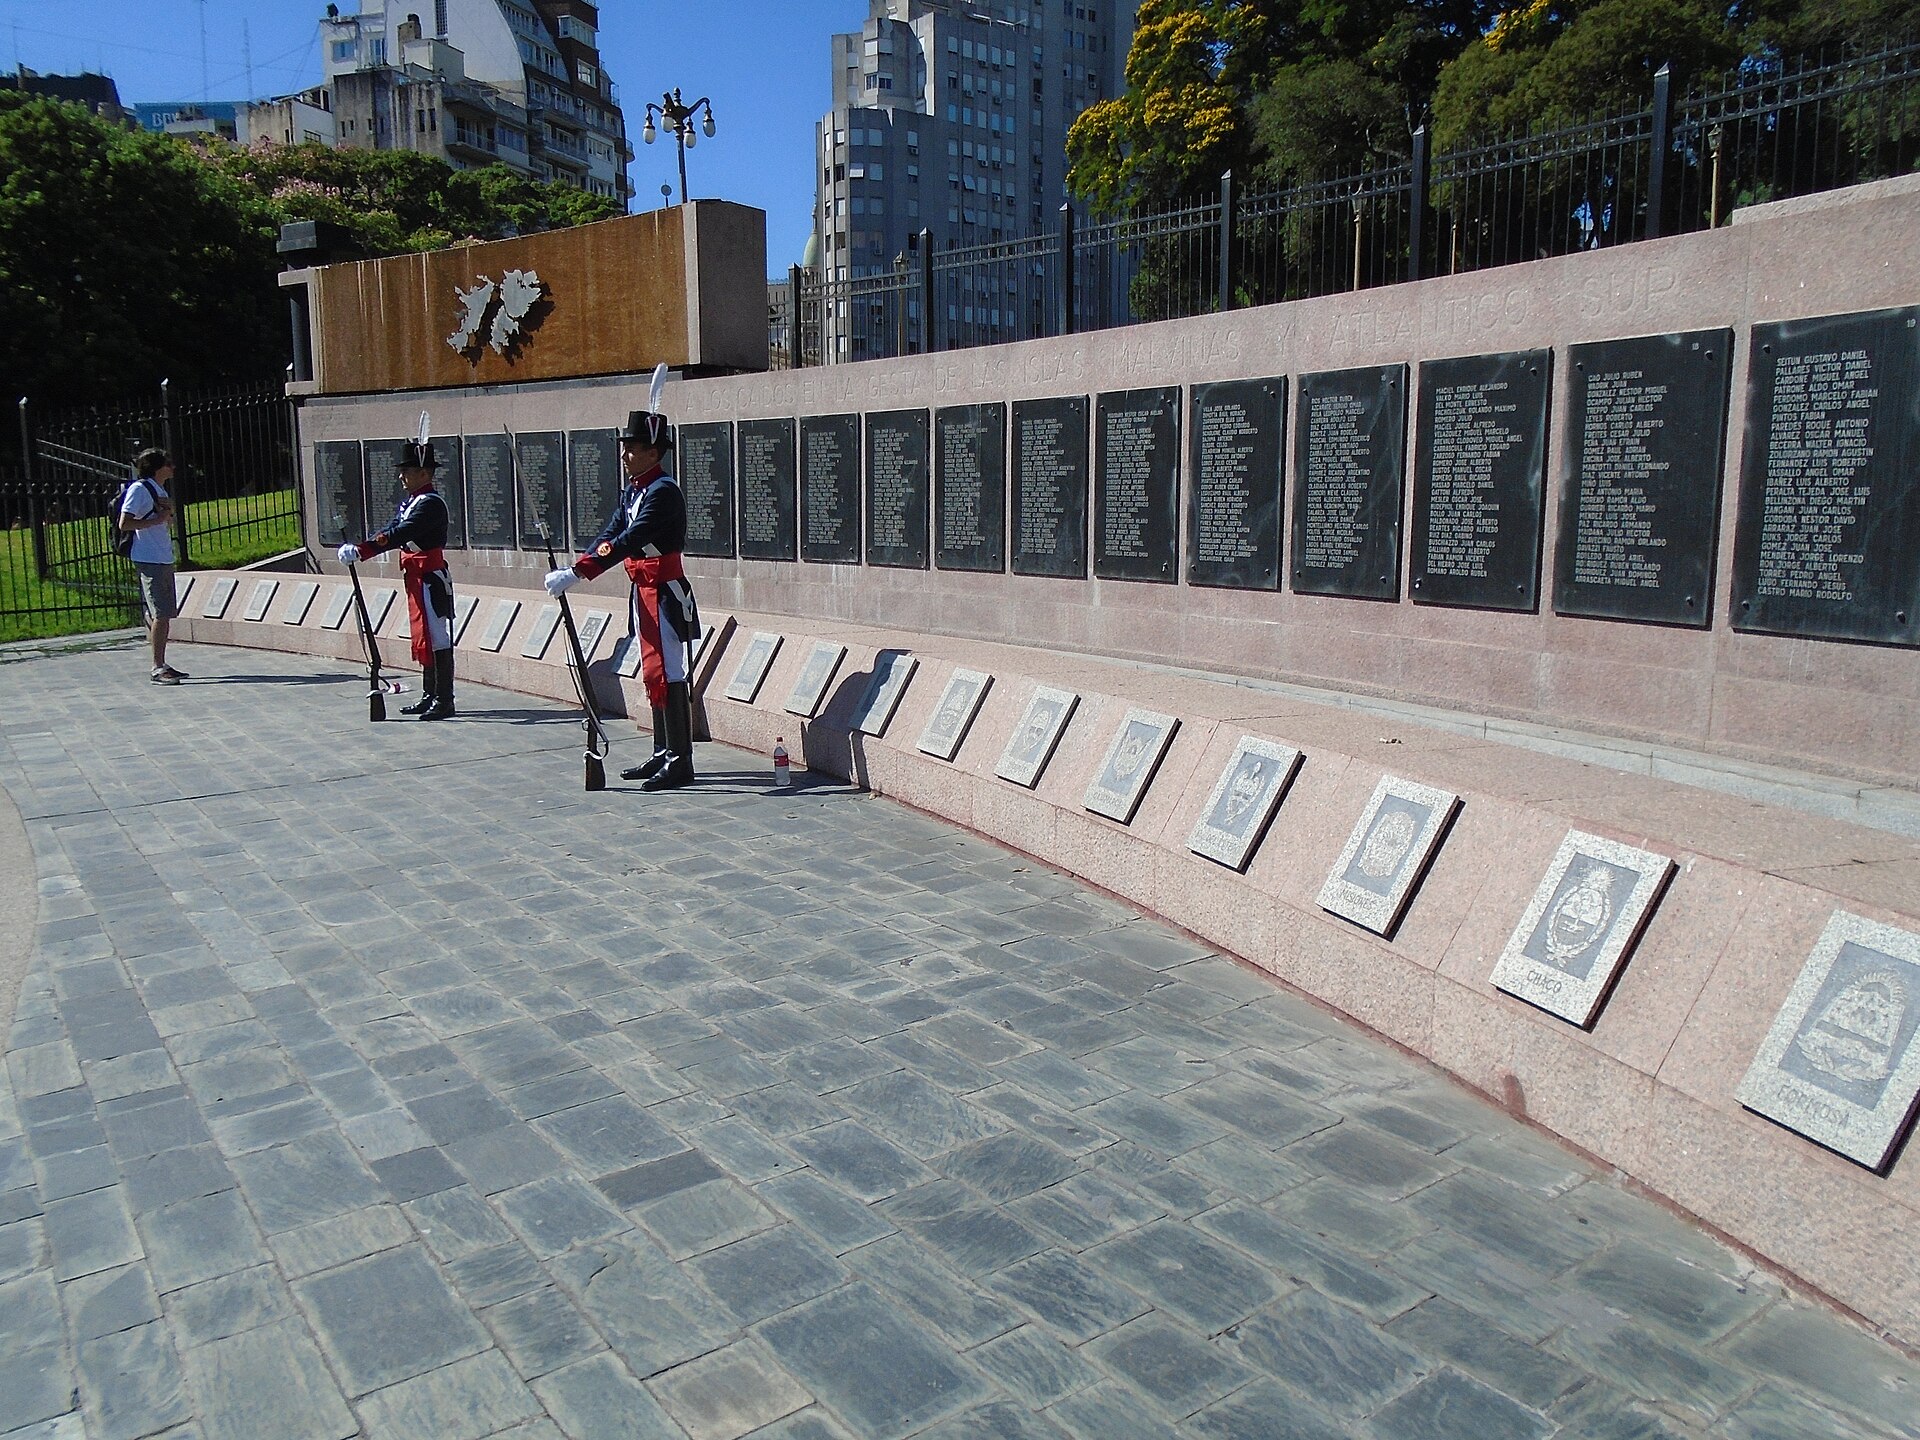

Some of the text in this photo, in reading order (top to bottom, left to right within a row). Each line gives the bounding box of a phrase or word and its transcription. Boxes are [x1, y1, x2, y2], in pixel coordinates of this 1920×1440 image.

[1804, 353, 1837, 364] GUSTAVO
[1842, 350, 1867, 360] DANIEL
[935, 366, 956, 392] DE
[972, 361, 1006, 388] LAS
[1022, 350, 1083, 385] ISLAS
[1776, 360, 1872, 376] PALLARES VICTOR DANIEL
[1812, 373, 1840, 382] MIGUEL
[1844, 370, 1868, 379] ANGEL
[1774, 381, 1854, 394] PATRONE ALDO OMAR
[1587, 389, 1617, 398] GONZALEZ
[1774, 389, 1878, 404] PERDOMO MARCELO FABIAN
[1587, 395, 1663, 406] OCAMPO HECTOR
[1611, 405, 1627, 413] JUAN
[1773, 400, 1870, 412] GONZALEZ CARLOS ANGEL
[1606, 413, 1633, 421] ROBERTO
[1772, 412, 1825, 421] PINTOS FABIAN
[1611, 421, 1633, 429] CARLOS
[1636, 420, 1664, 428] ALBERTO
[1771, 419, 1868, 431] PAREDES ROQUE ANTONIO
[1771, 429, 1865, 441] ALVAREZ OSCAR MANUEL
[1770, 438, 1867, 449] BECERRA WALTER IGNACIO
[1813, 449, 1838, 457] RAMON
[1841, 448, 1874, 457] AGUSTIN
[1624, 454, 1651, 462] ALBERTO
[1768, 458, 1866, 468] FERNANDEZ LUIS ROBERTO
[1638, 462, 1669, 470] FERNANDO
[1768, 468, 1854, 477] VASSALLO ANGEL OMAR
[1767, 477, 1849, 486] IBAÑEZ LUIS ALBERTO
[1766, 487, 1870, 496] PERALTA TEJEDA JOSE LUIS
[1810, 497, 1832, 505] DIEGO
[1837, 497, 1866, 505] MARTIN
[1799, 506, 1818, 514] JUAN
[1822, 506, 1852, 515] CARLOS
[1764, 515, 1856, 524] CORDOBA NESTOR DAVID
[1621, 521, 1651, 529] ARMANDO
[1800, 525, 1818, 533] JUAN
[1823, 526, 1842, 534] JOSE
[1785, 534, 1808, 542] JORGE
[1813, 535, 1842, 543] CARLOS
[1761, 542, 1832, 552] GOMEZ JUAN JOSE
[1760, 551, 1864, 563] MENDIETA JORGE LORENZO
[1777, 561, 1801, 569] JORGE
[1805, 563, 1838, 571] ALBERTO
[1759, 569, 1841, 581] TORRES PEDRO ANGEL
[1758, 578, 1846, 590] LUGO FERNANDO JESUS
[1758, 586, 1852, 600] CASTRO MARIO RODOLFO
[1527, 970, 1562, 993] CHACO
